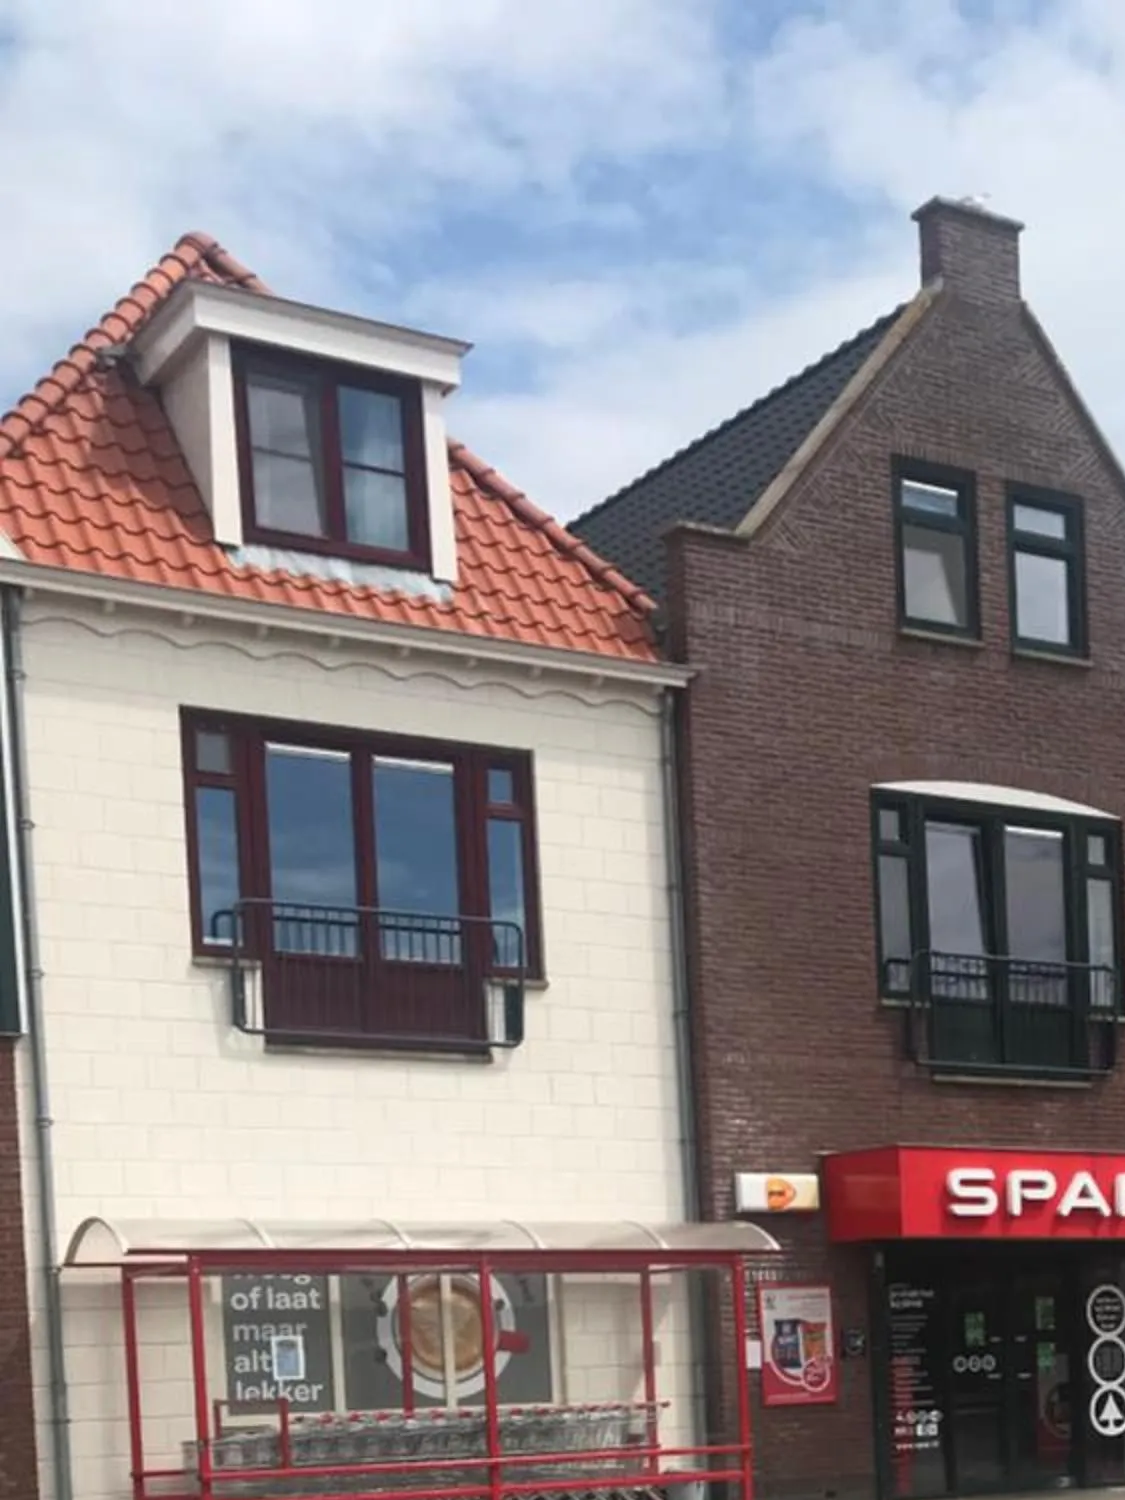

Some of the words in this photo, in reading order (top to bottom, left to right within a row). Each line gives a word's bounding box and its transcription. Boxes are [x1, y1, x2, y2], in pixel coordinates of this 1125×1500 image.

[230, 1286, 262, 1310] of
[266, 1286, 321, 1310] laat
[233, 1323, 308, 1341] maar
[234, 1349, 274, 1373] alt
[236, 1380, 324, 1402] lekker
